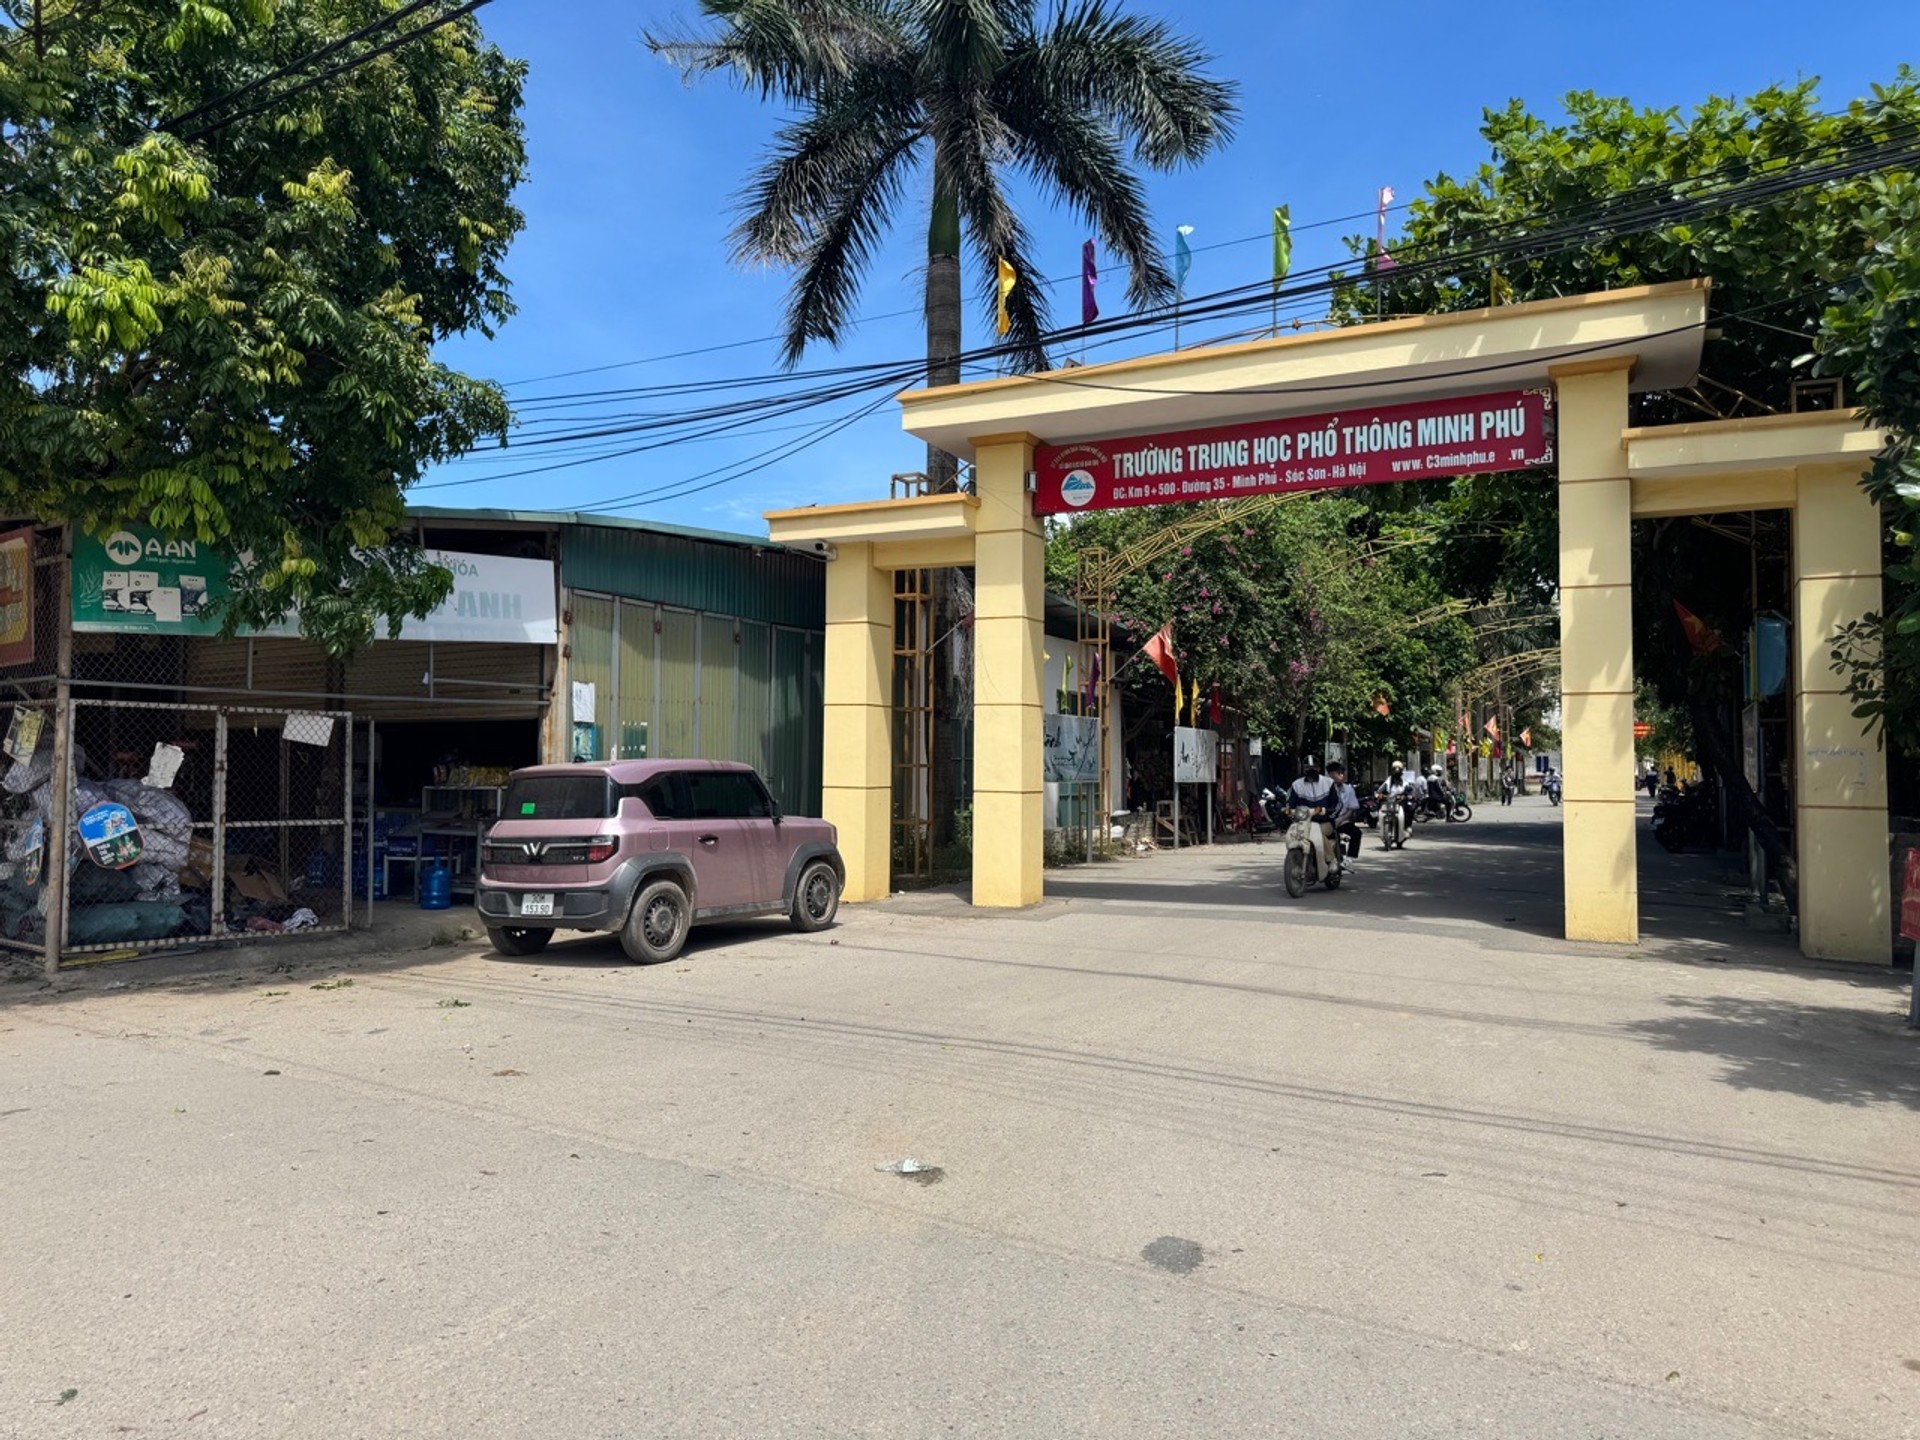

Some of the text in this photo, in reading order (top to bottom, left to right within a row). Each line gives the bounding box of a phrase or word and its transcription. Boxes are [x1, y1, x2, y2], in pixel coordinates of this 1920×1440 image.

[1112, 443, 1183, 479] TRƯỜNG
[1187, 439, 1249, 471] TRUNG
[1253, 434, 1292, 469] HỌC
[1297, 417, 1339, 460] PHỔ
[1342, 415, 1413, 455] THÔNG
[1417, 412, 1475, 447] MINH
[1480, 400, 1525, 441] PHÚ
[1128, 486, 1143, 498] Km
[1182, 479, 1211, 493] Đường
[1213, 477, 1225, 490] 35
[1232, 474, 1257, 488] Minh
[1258, 471, 1277, 486] Phú
[1348, 462, 1366, 479] Nội
